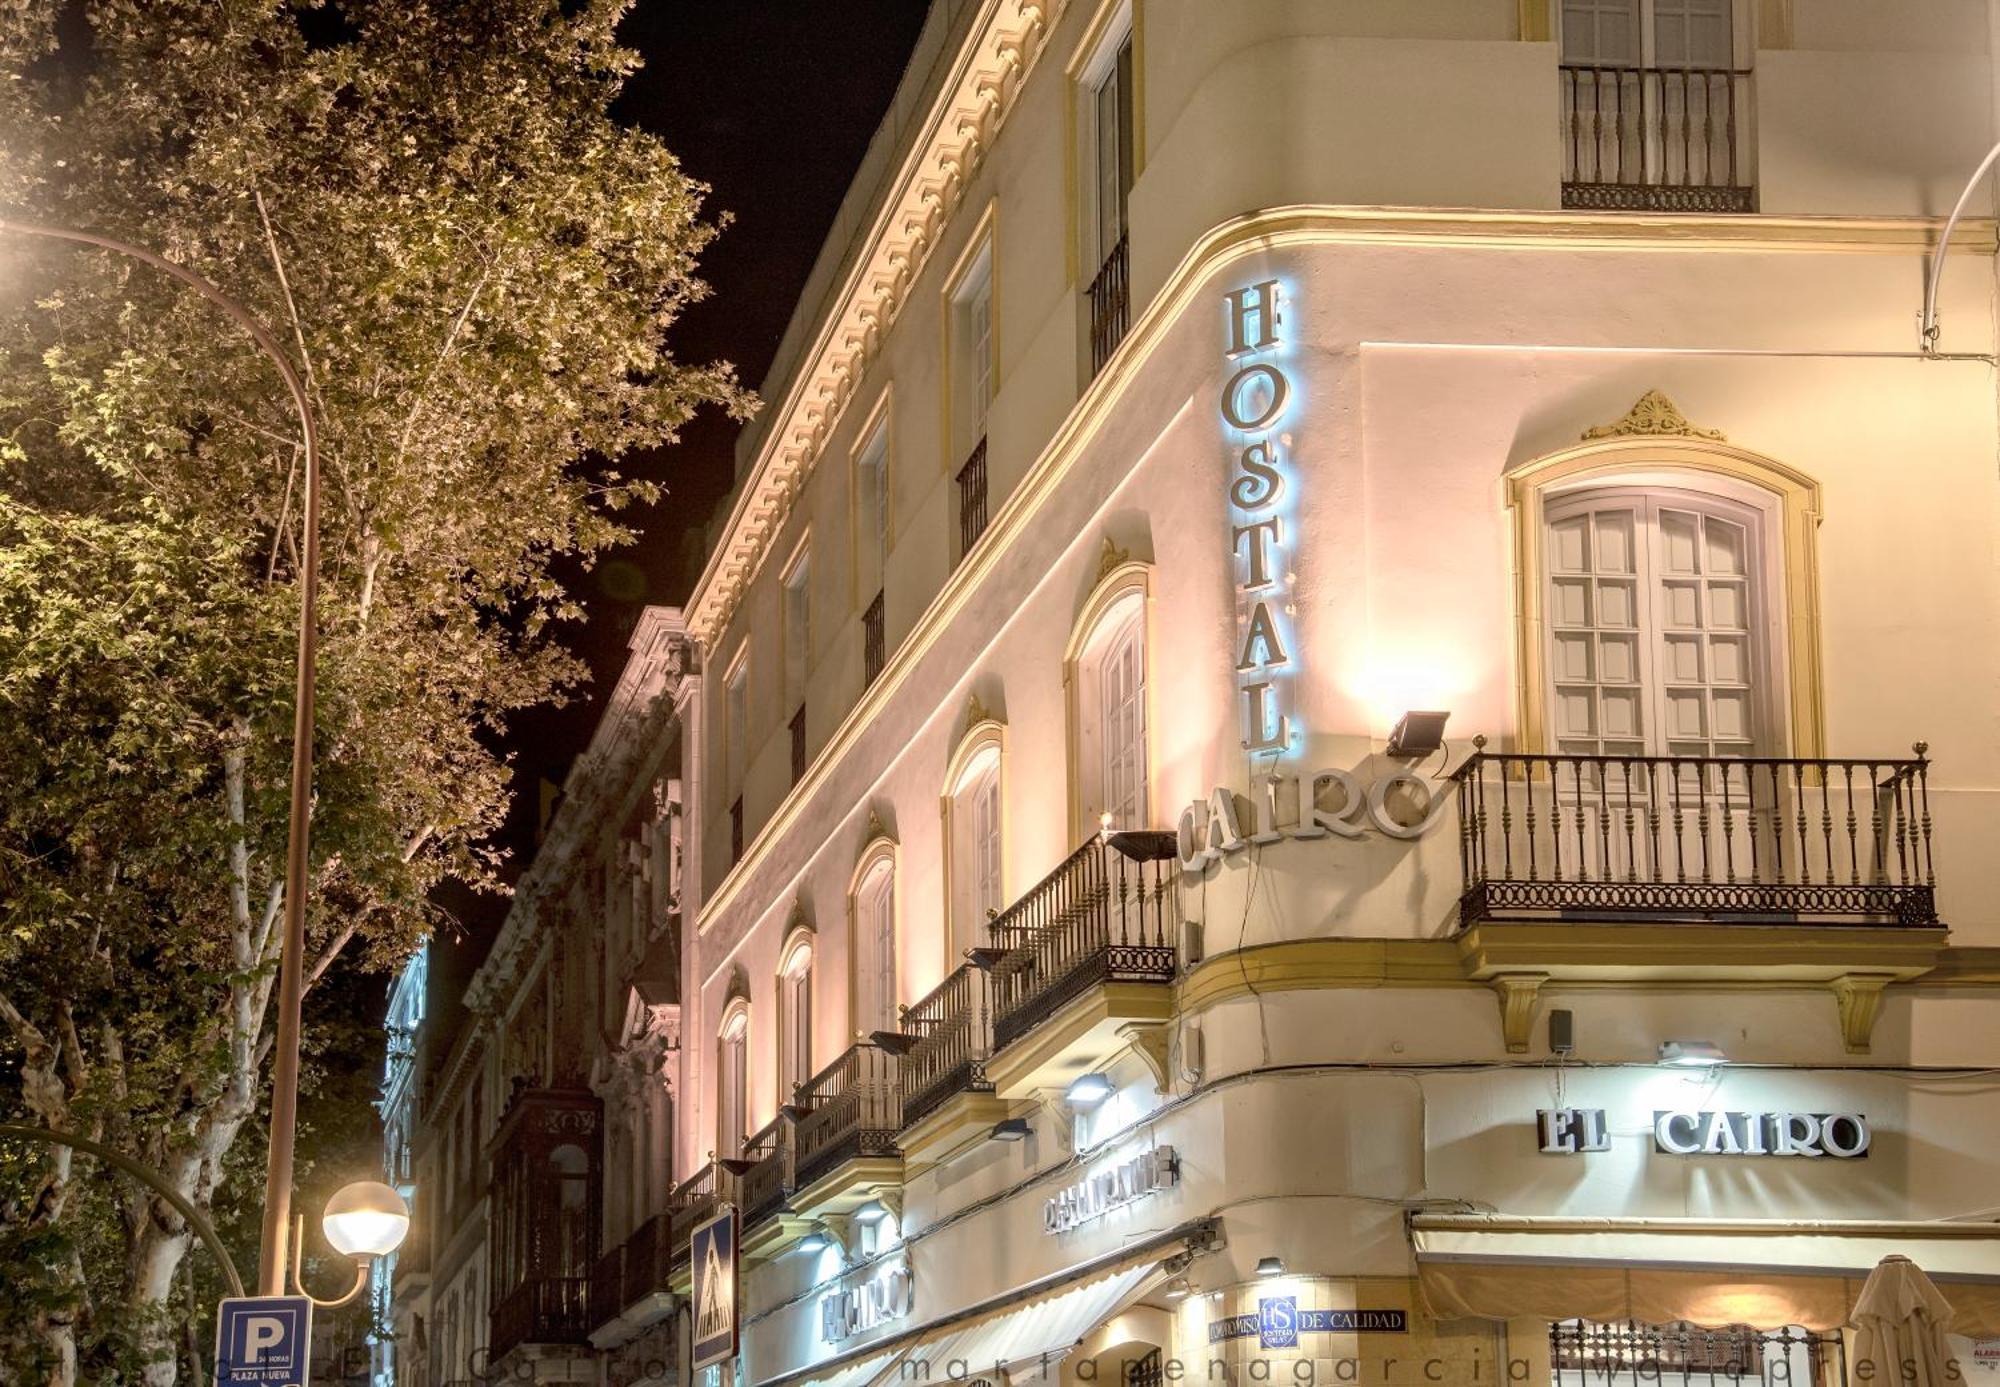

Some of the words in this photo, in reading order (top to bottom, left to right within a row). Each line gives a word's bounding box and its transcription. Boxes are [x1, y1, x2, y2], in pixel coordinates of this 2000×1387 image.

[1221, 279, 1291, 754] HOSTAL
[1177, 768, 1442, 871] CAIRO
[1541, 1107, 1612, 1154] EL
[1655, 1110, 1872, 1158] CAIRO
[245, 1317, 284, 1363] P
[1302, 1313, 1324, 1328] DE
[1330, 1312, 1401, 1328] CALIDAD
[231, 1371, 258, 1381] PLAZA
[262, 1370, 291, 1380] NUEVA
